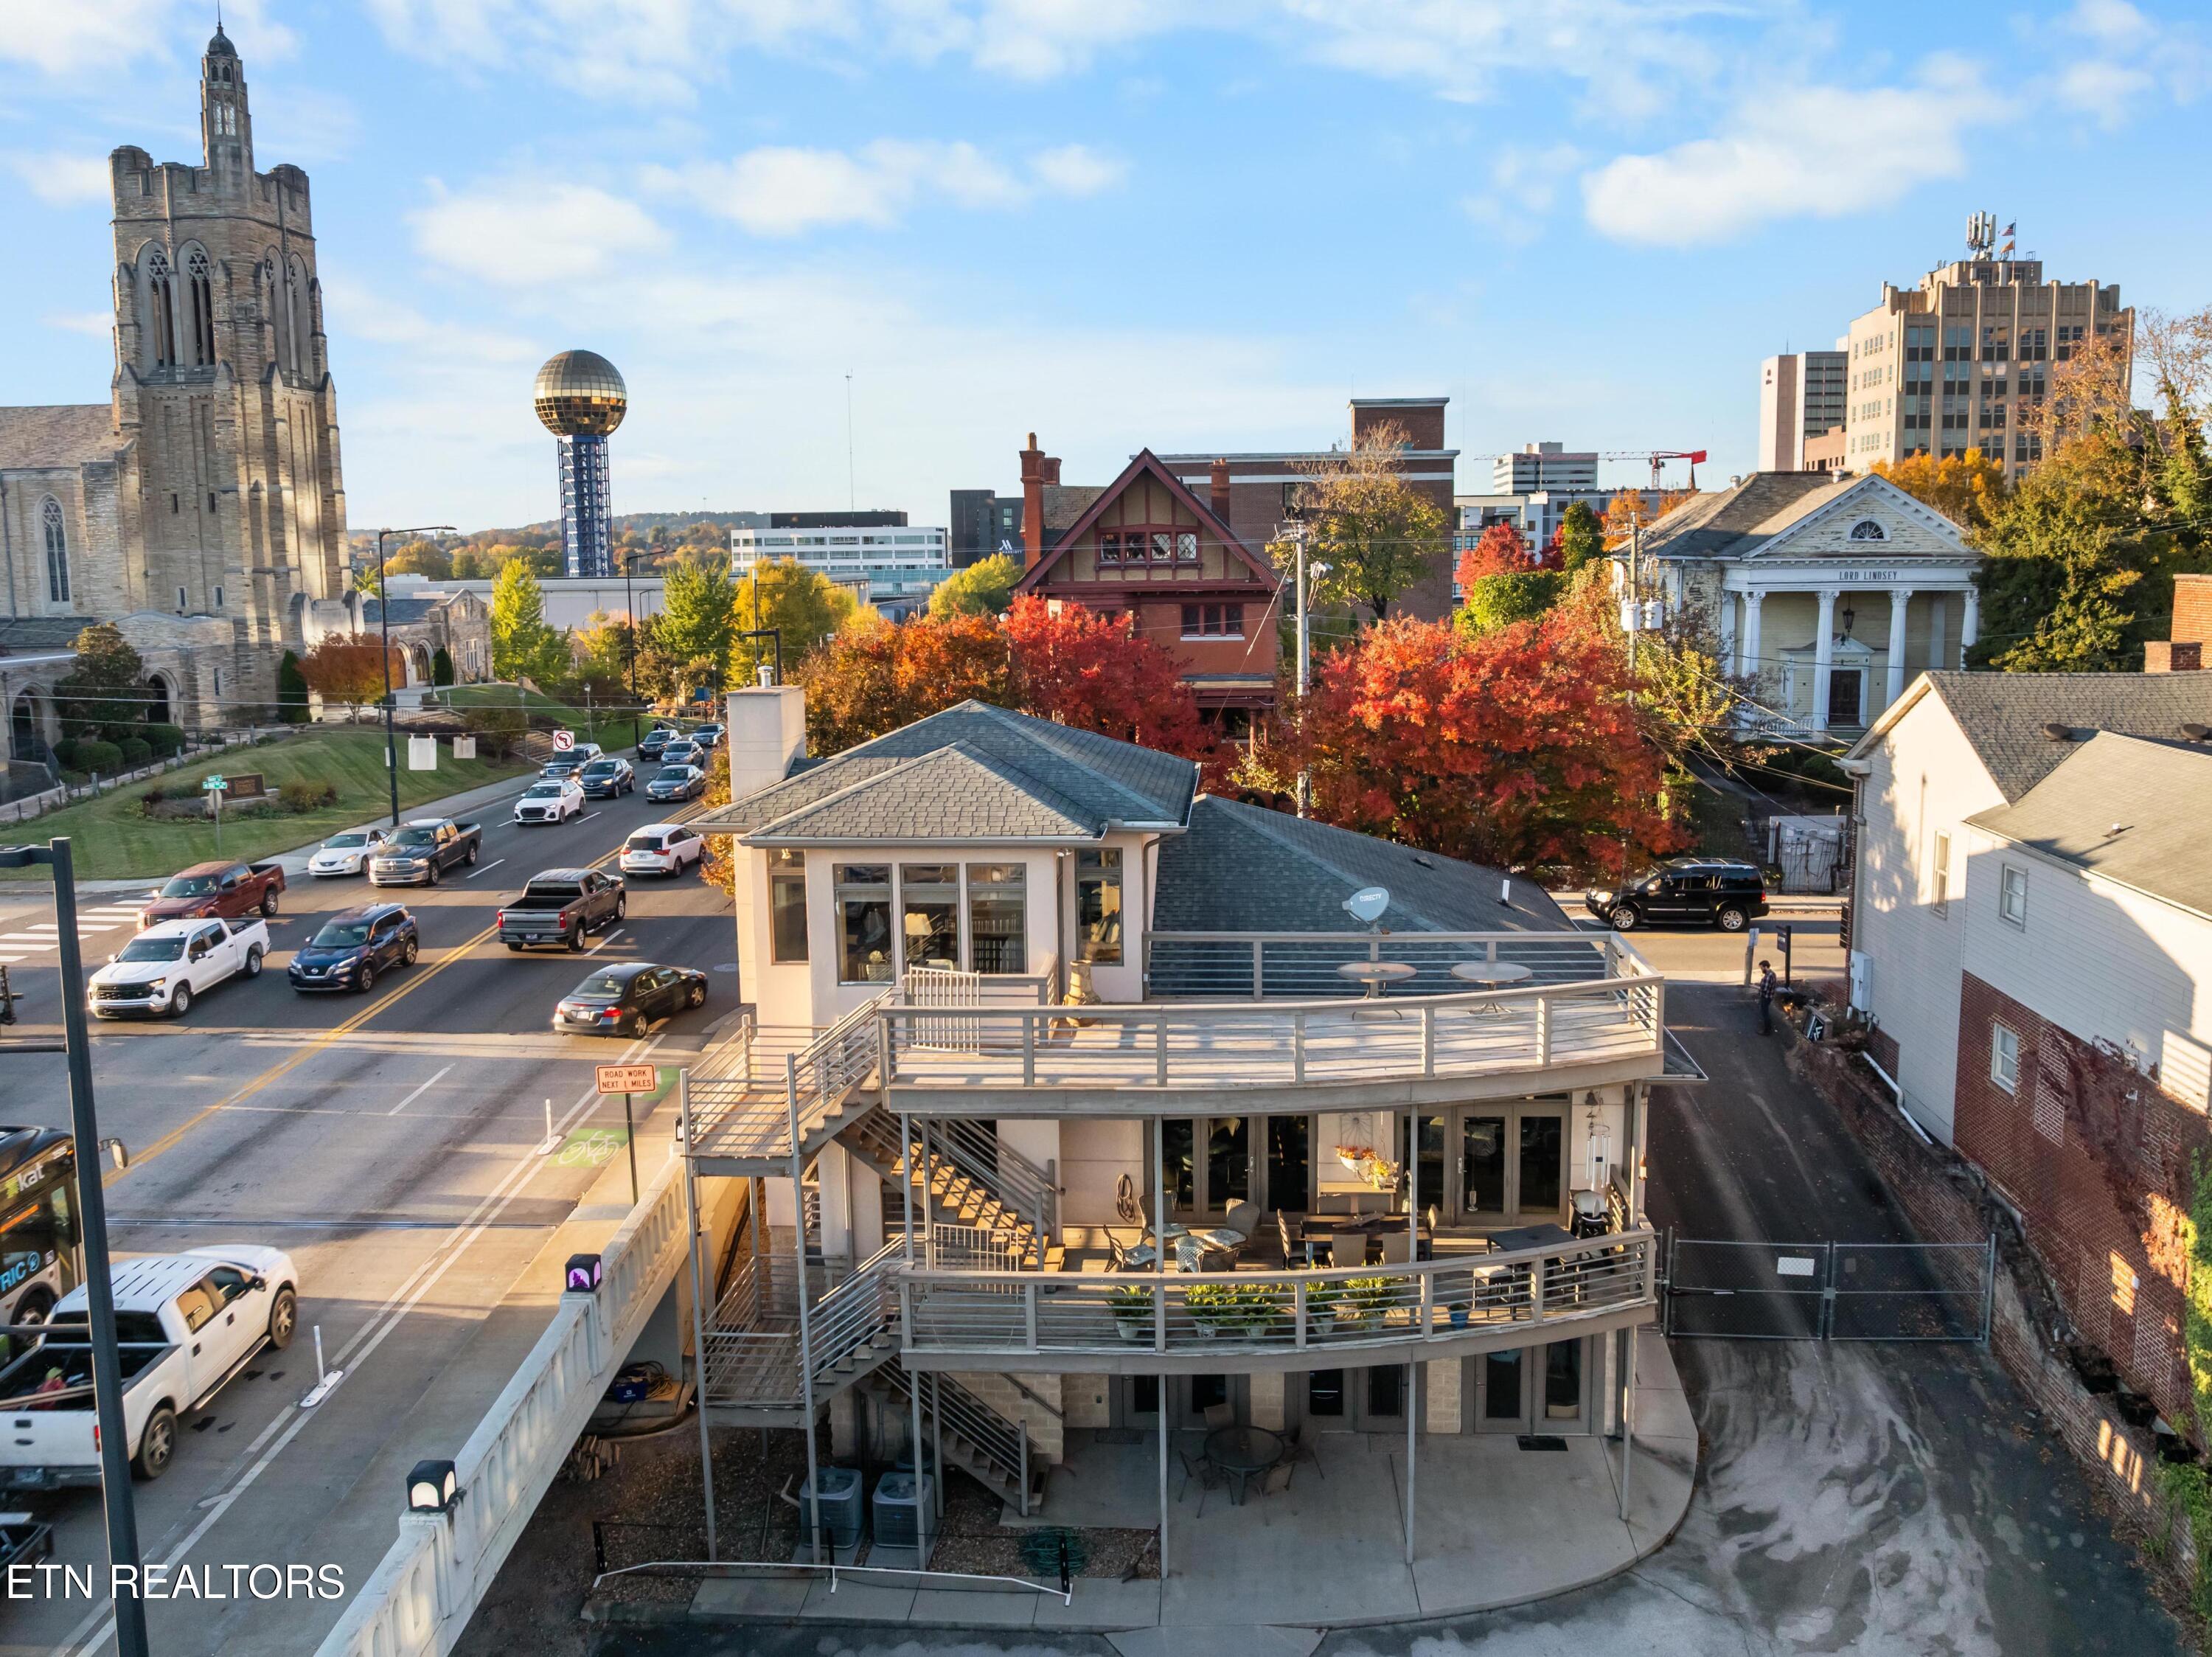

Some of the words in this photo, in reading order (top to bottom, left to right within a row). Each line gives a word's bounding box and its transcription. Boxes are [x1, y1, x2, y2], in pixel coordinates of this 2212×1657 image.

[1839, 571, 1859, 580] LORD
[1863, 571, 1898, 580] LINDSEY
[605, 1070, 624, 1078] ROAD
[627, 1069, 647, 1077] WORK
[602, 1080, 619, 1088] NEXT
[631, 1080, 652, 1088] MILES
[17, 1164, 46, 1192] kat
[0, 1261, 27, 1292] RIC
